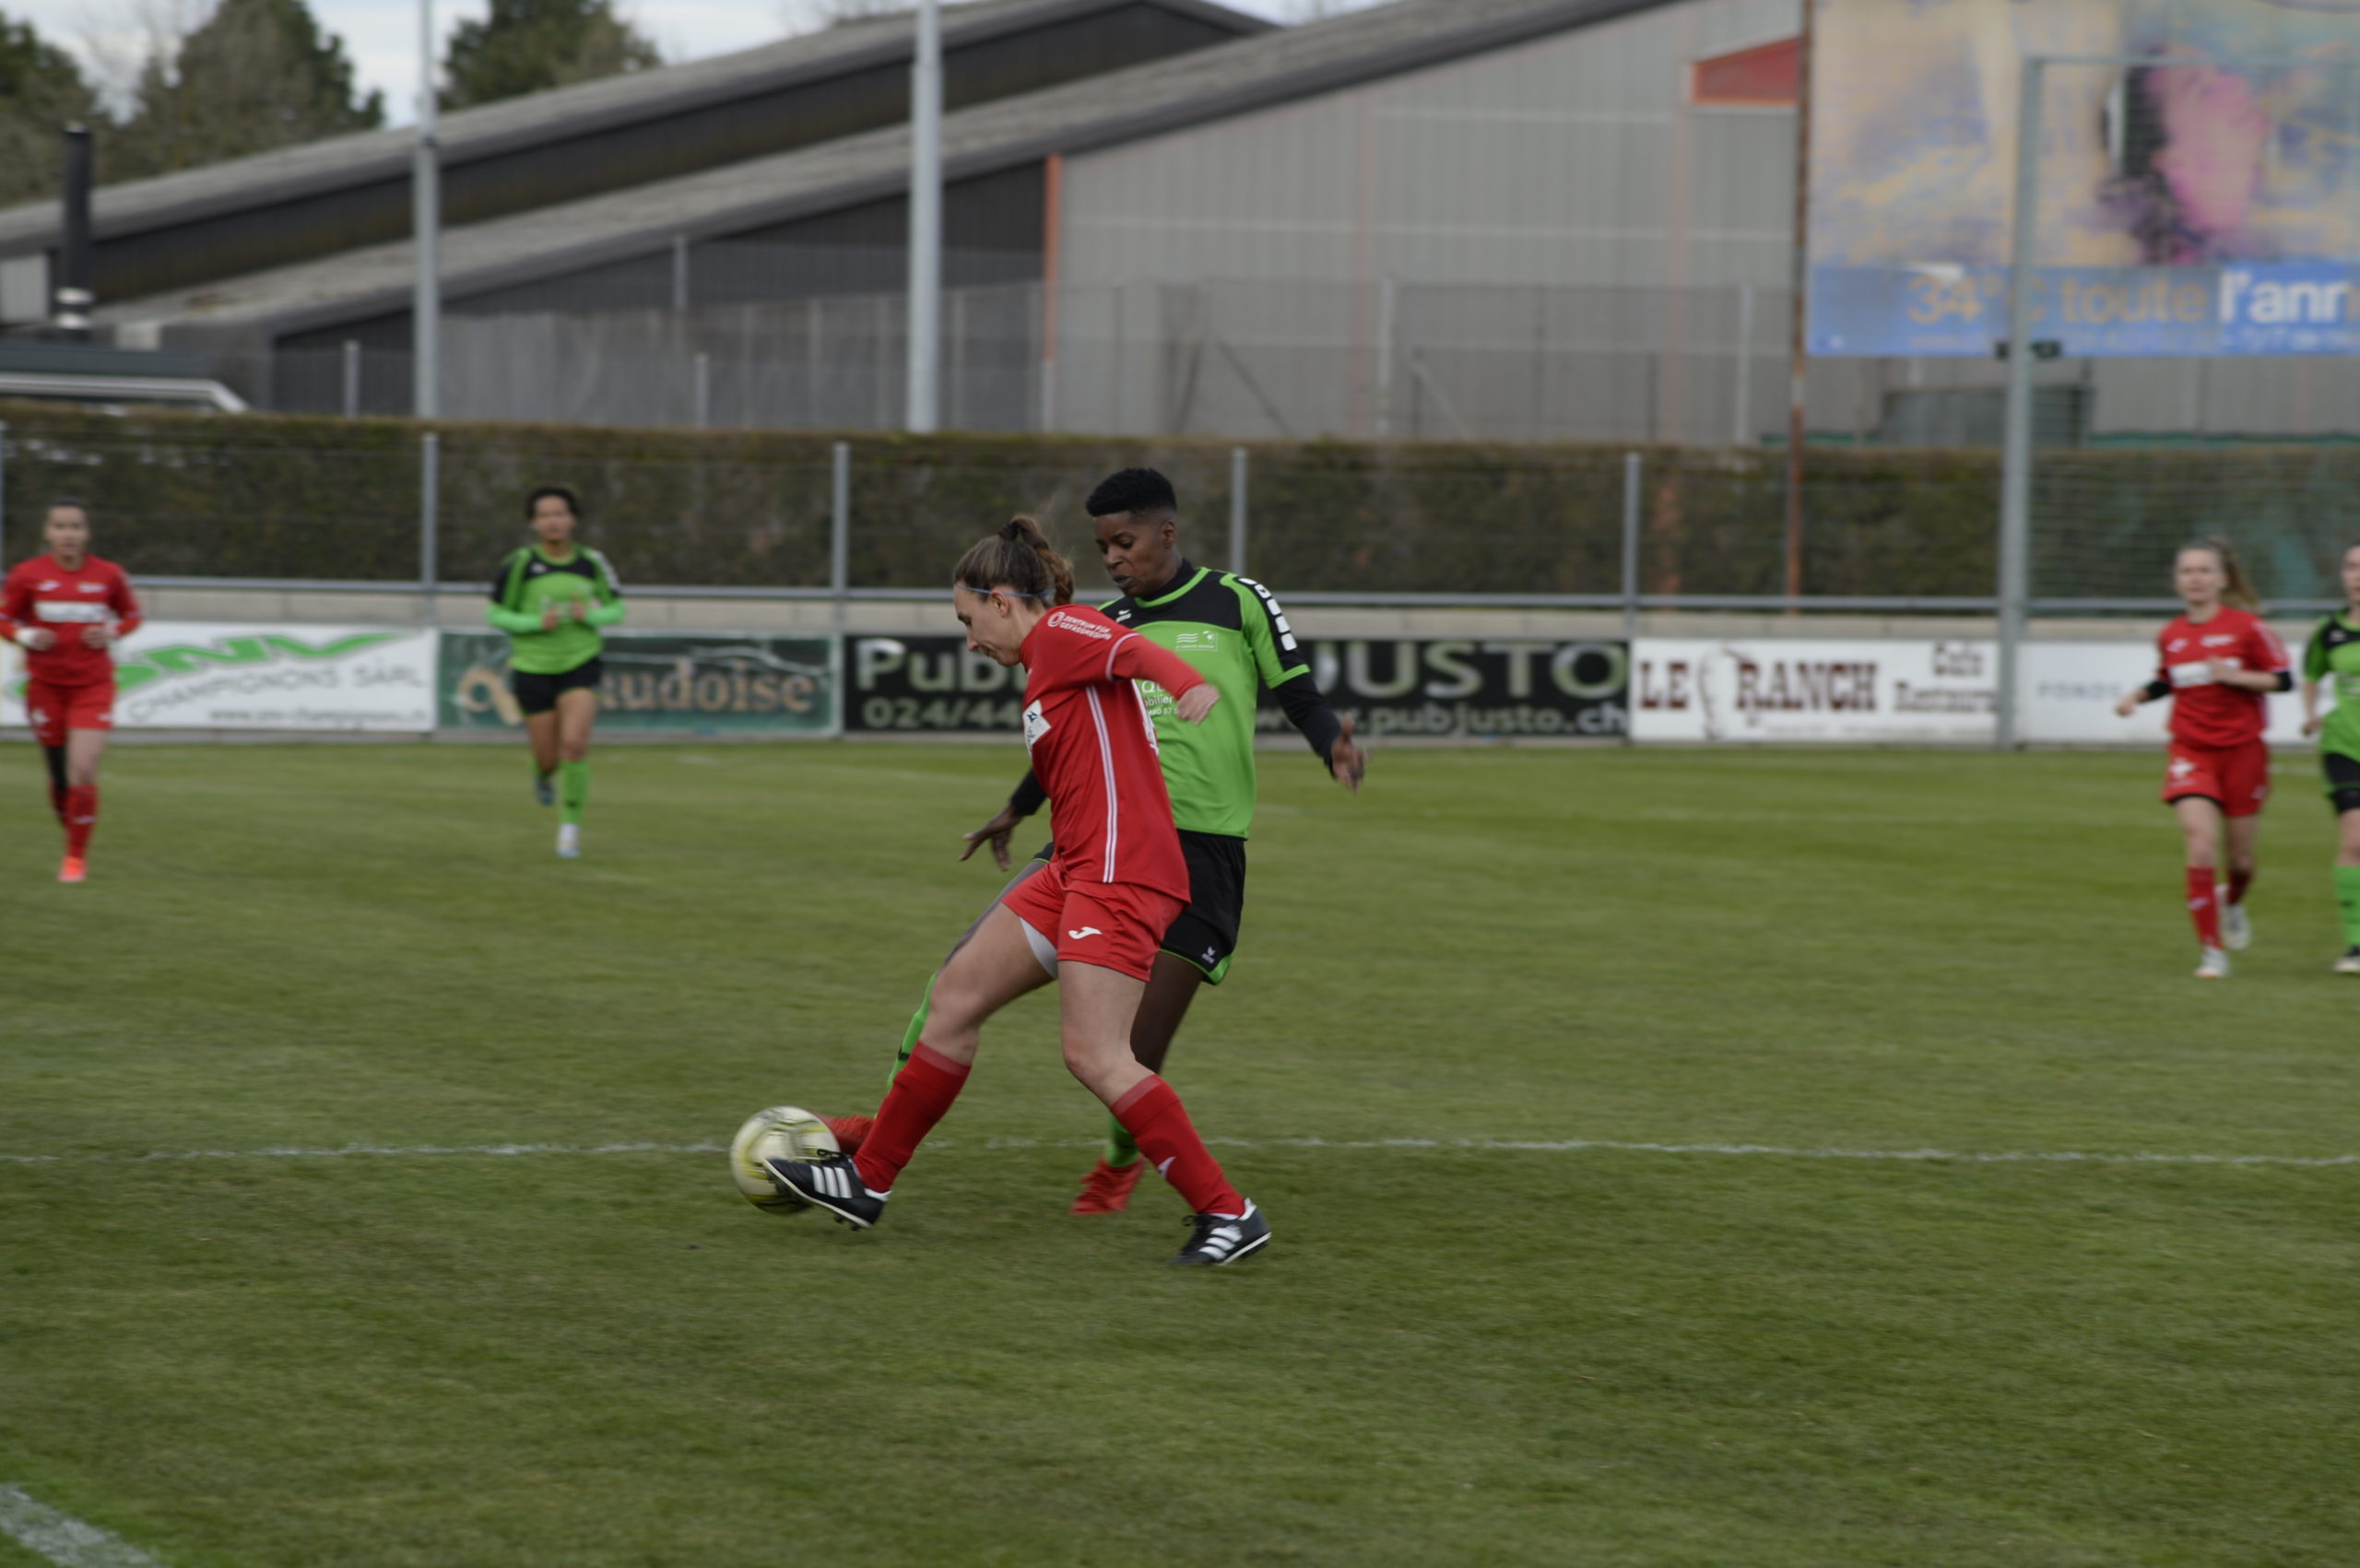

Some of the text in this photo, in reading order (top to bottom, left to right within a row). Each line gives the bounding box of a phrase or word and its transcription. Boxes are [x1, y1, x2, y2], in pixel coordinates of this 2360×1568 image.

[2060, 276, 2207, 324] toute
[1640, 661, 1688, 711] LE
[1737, 661, 1877, 712] RANCH
